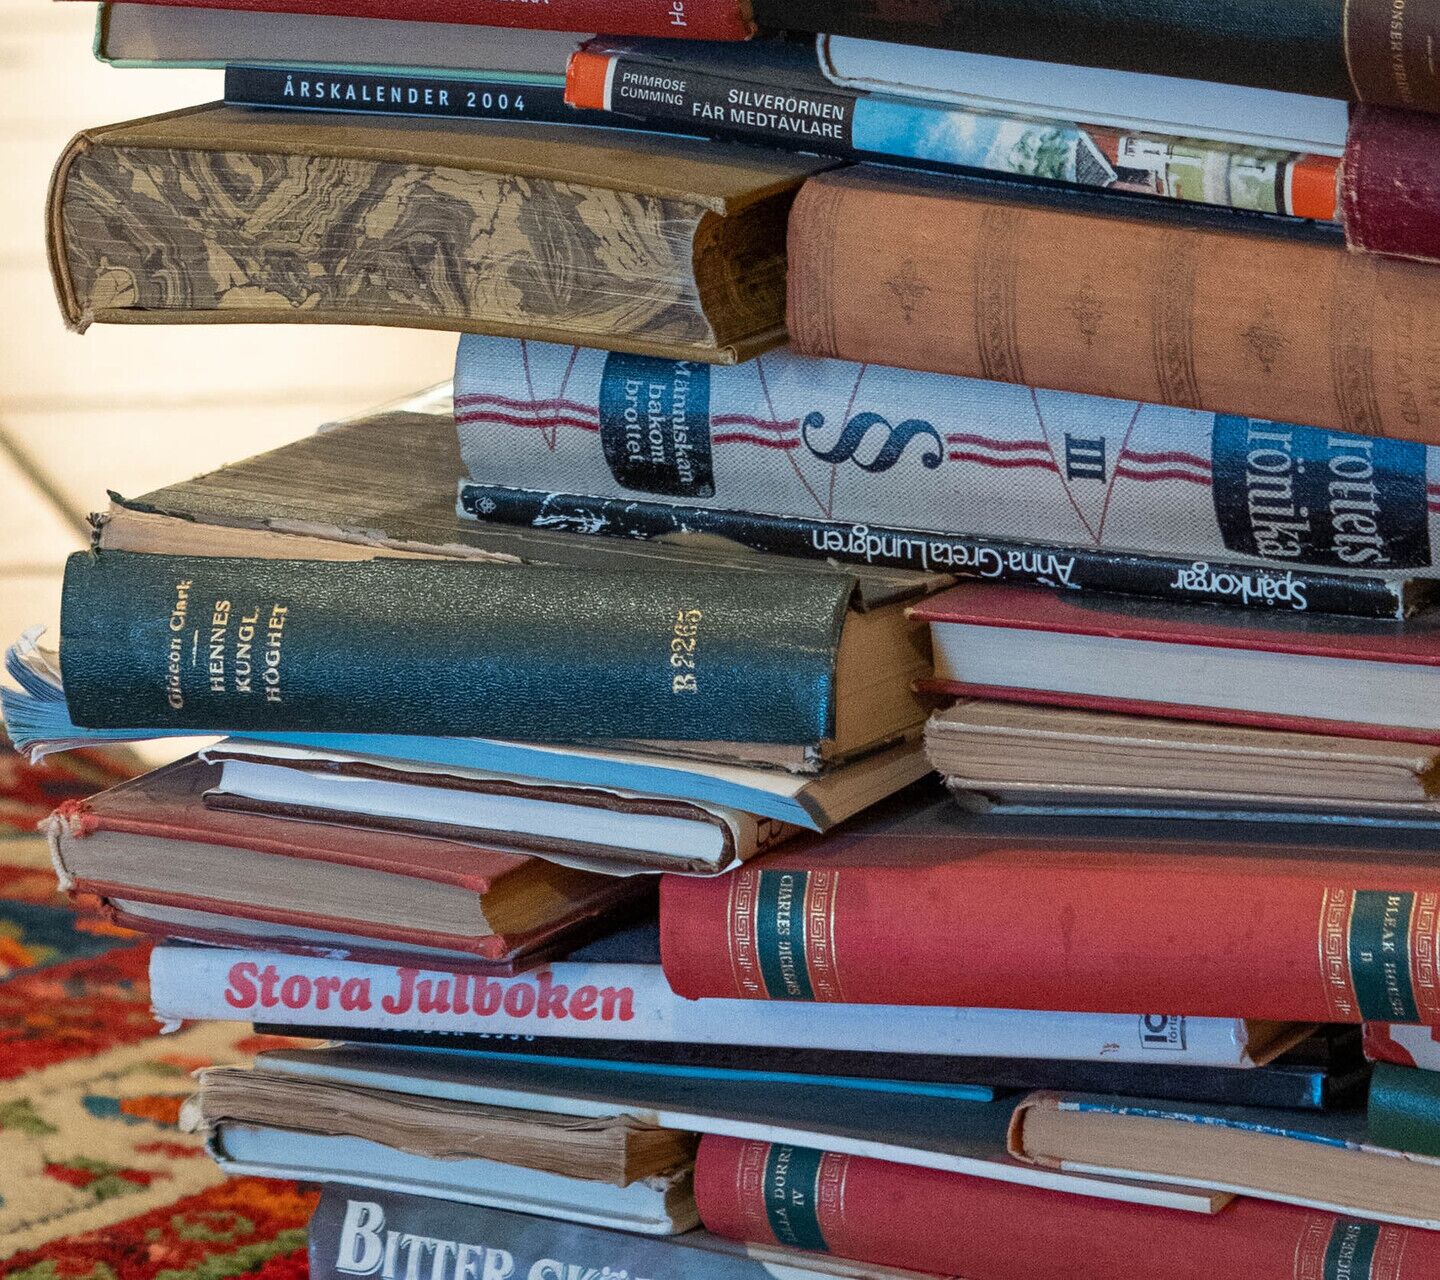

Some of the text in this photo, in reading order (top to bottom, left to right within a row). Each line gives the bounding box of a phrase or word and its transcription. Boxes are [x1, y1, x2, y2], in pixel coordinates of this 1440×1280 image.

[283, 74, 526, 111] ÅRSKALENDER 2004
[620, 86, 684, 106] CUMMING
[622, 71, 688, 92] PRIMROSE
[728, 87, 845, 122] SILVERÖRNEN
[692, 101, 844, 140] FÅR MEDTÄVLARE
[623, 378, 646, 463] brottet
[648, 383, 667, 464] bakom
[1246, 417, 1311, 558] rönika
[812, 526, 928, 571] Lundgren
[1170, 557, 1308, 611] Spånkorgar
[165, 579, 193, 710] Gideon Clark
[209, 600, 231, 692] HENNES
[235, 604, 260, 693] KUNGL.
[262, 603, 289, 703] HÖGHET
[671, 673, 699, 694] B
[776, 874, 801, 996] CHARLES DICKENS
[1381, 895, 1401, 952] BLEAK
[223, 960, 636, 1023] Stora Julboken
[792, 1187, 806, 1207] IV
